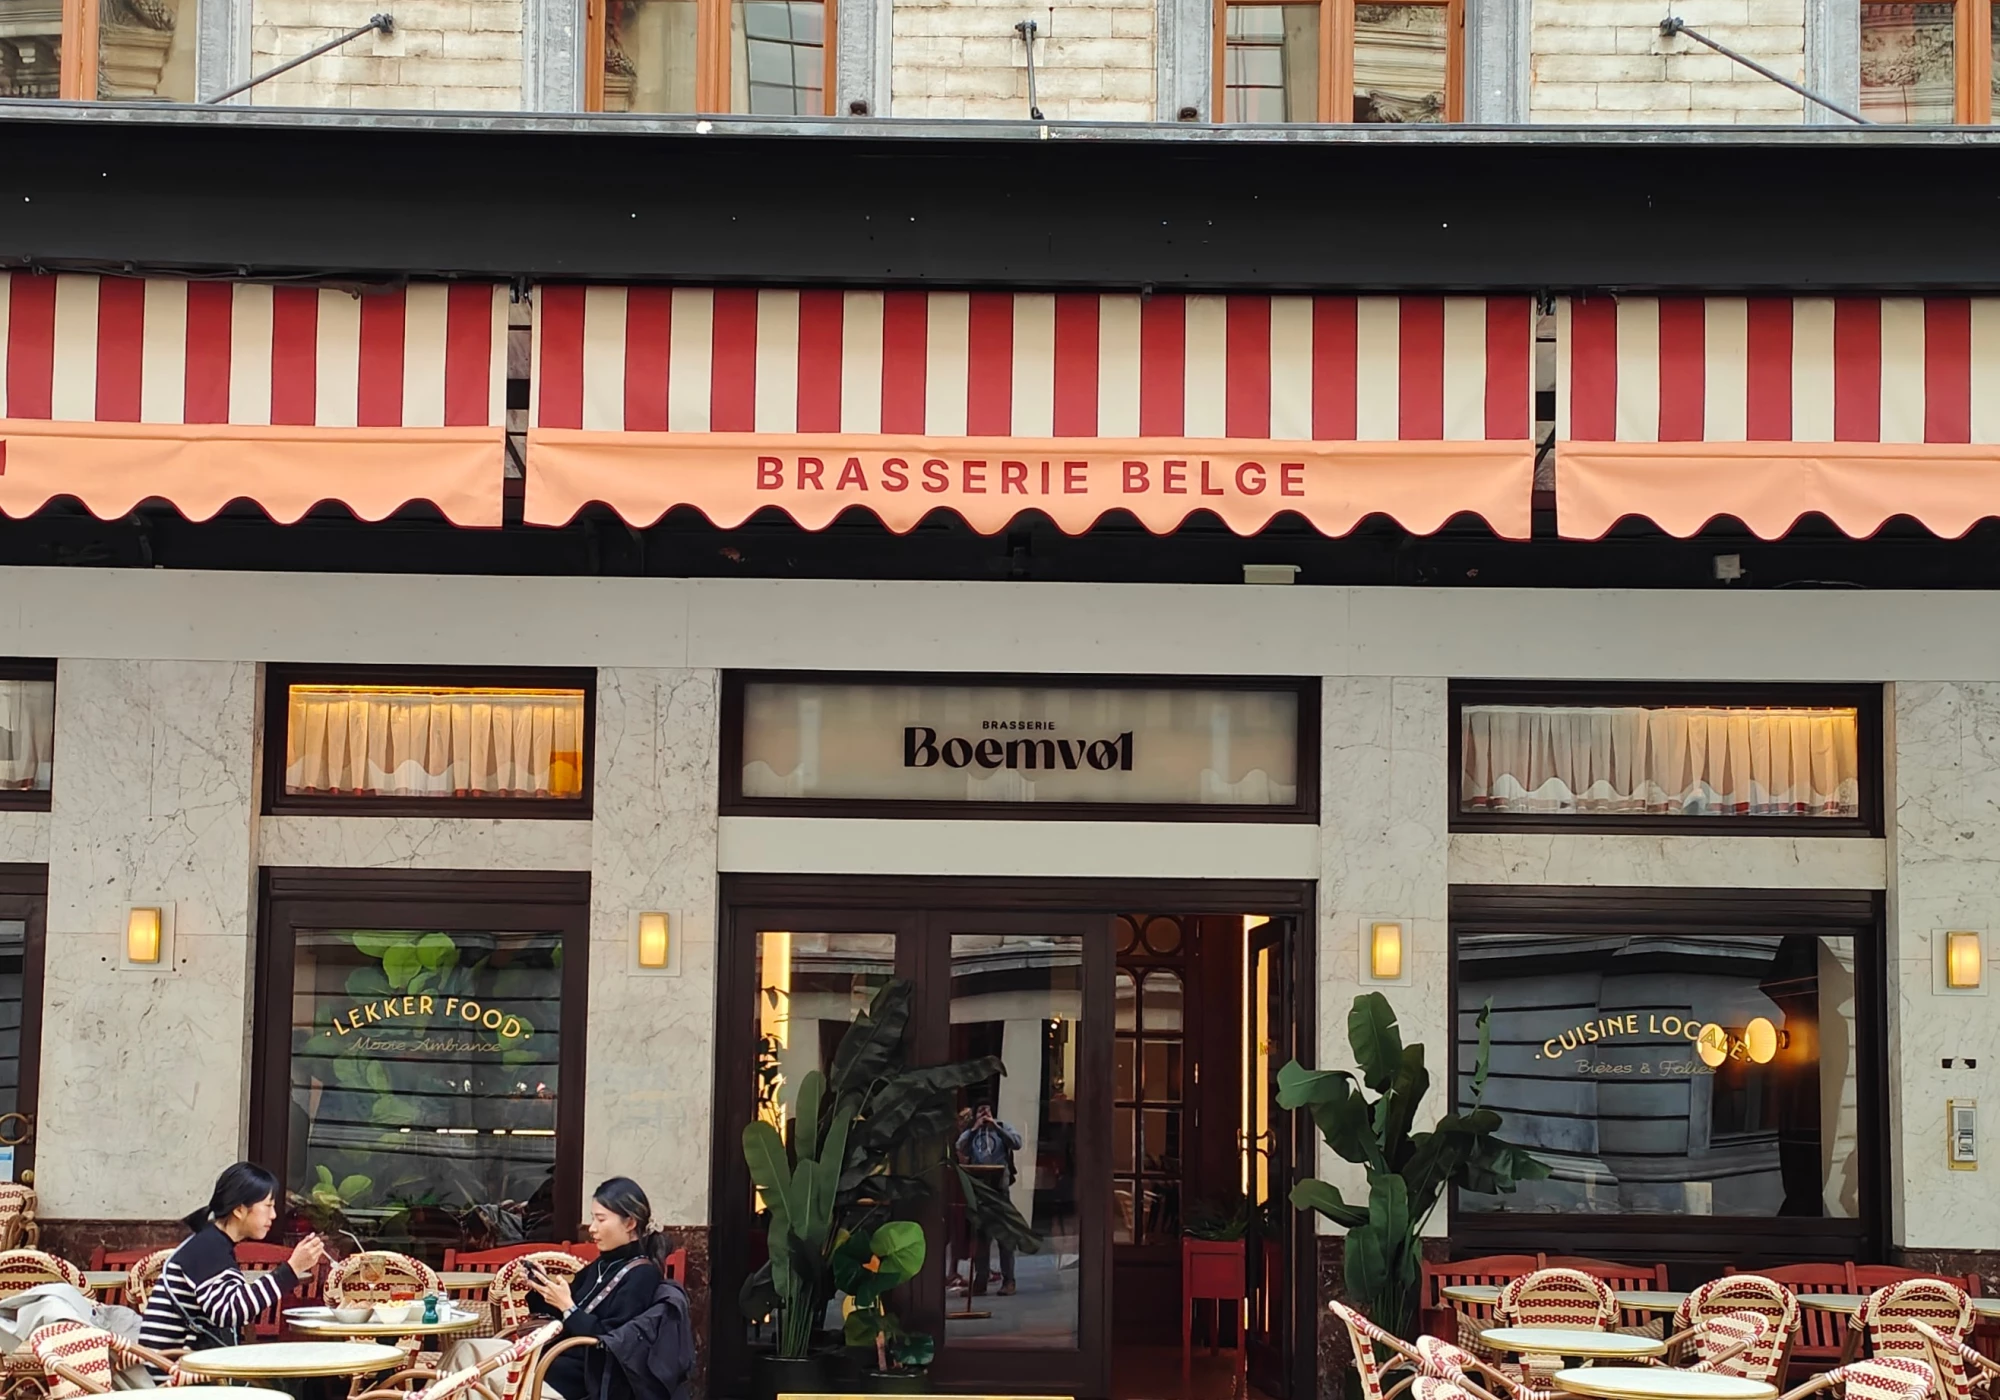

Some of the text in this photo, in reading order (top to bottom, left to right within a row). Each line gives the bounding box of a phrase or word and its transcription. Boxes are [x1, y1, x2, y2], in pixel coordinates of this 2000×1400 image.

[756, 456, 1306, 497] BRASSERIE BELGE
[982, 720, 1056, 731] BRASSERIE
[333, 995, 521, 1038] LEKKER FOOD
[350, 1036, 501, 1052] Mooie Ambiance
[1543, 1014, 1639, 1059] CUISINE
[1575, 1059, 1632, 1075] Bières
[1640, 1062, 1651, 1074] &
